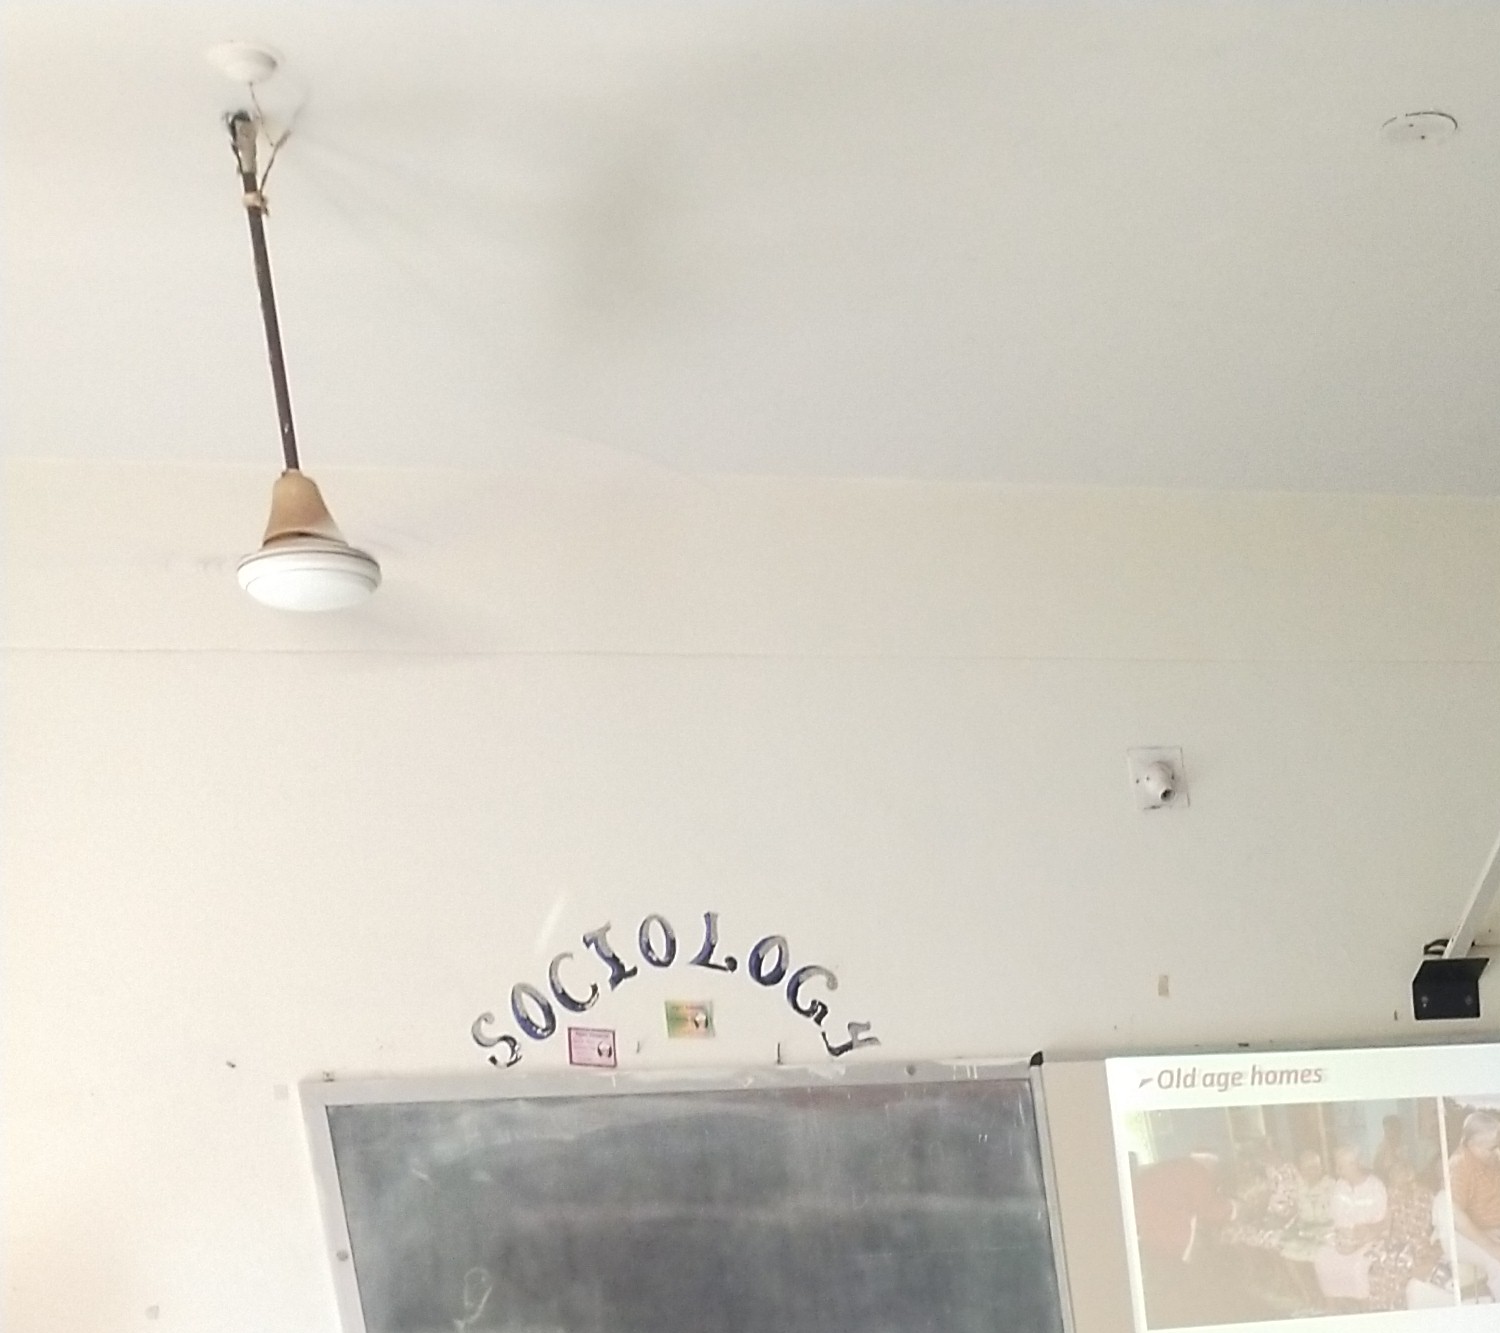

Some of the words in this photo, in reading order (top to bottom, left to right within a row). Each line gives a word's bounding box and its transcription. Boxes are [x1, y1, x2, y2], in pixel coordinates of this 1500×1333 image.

[471, 911, 882, 1068] SOCIOLOGY
[1157, 1067, 1197, 1090] Old
[1202, 1070, 1243, 1093] age
[1250, 1064, 1323, 1086] homes
